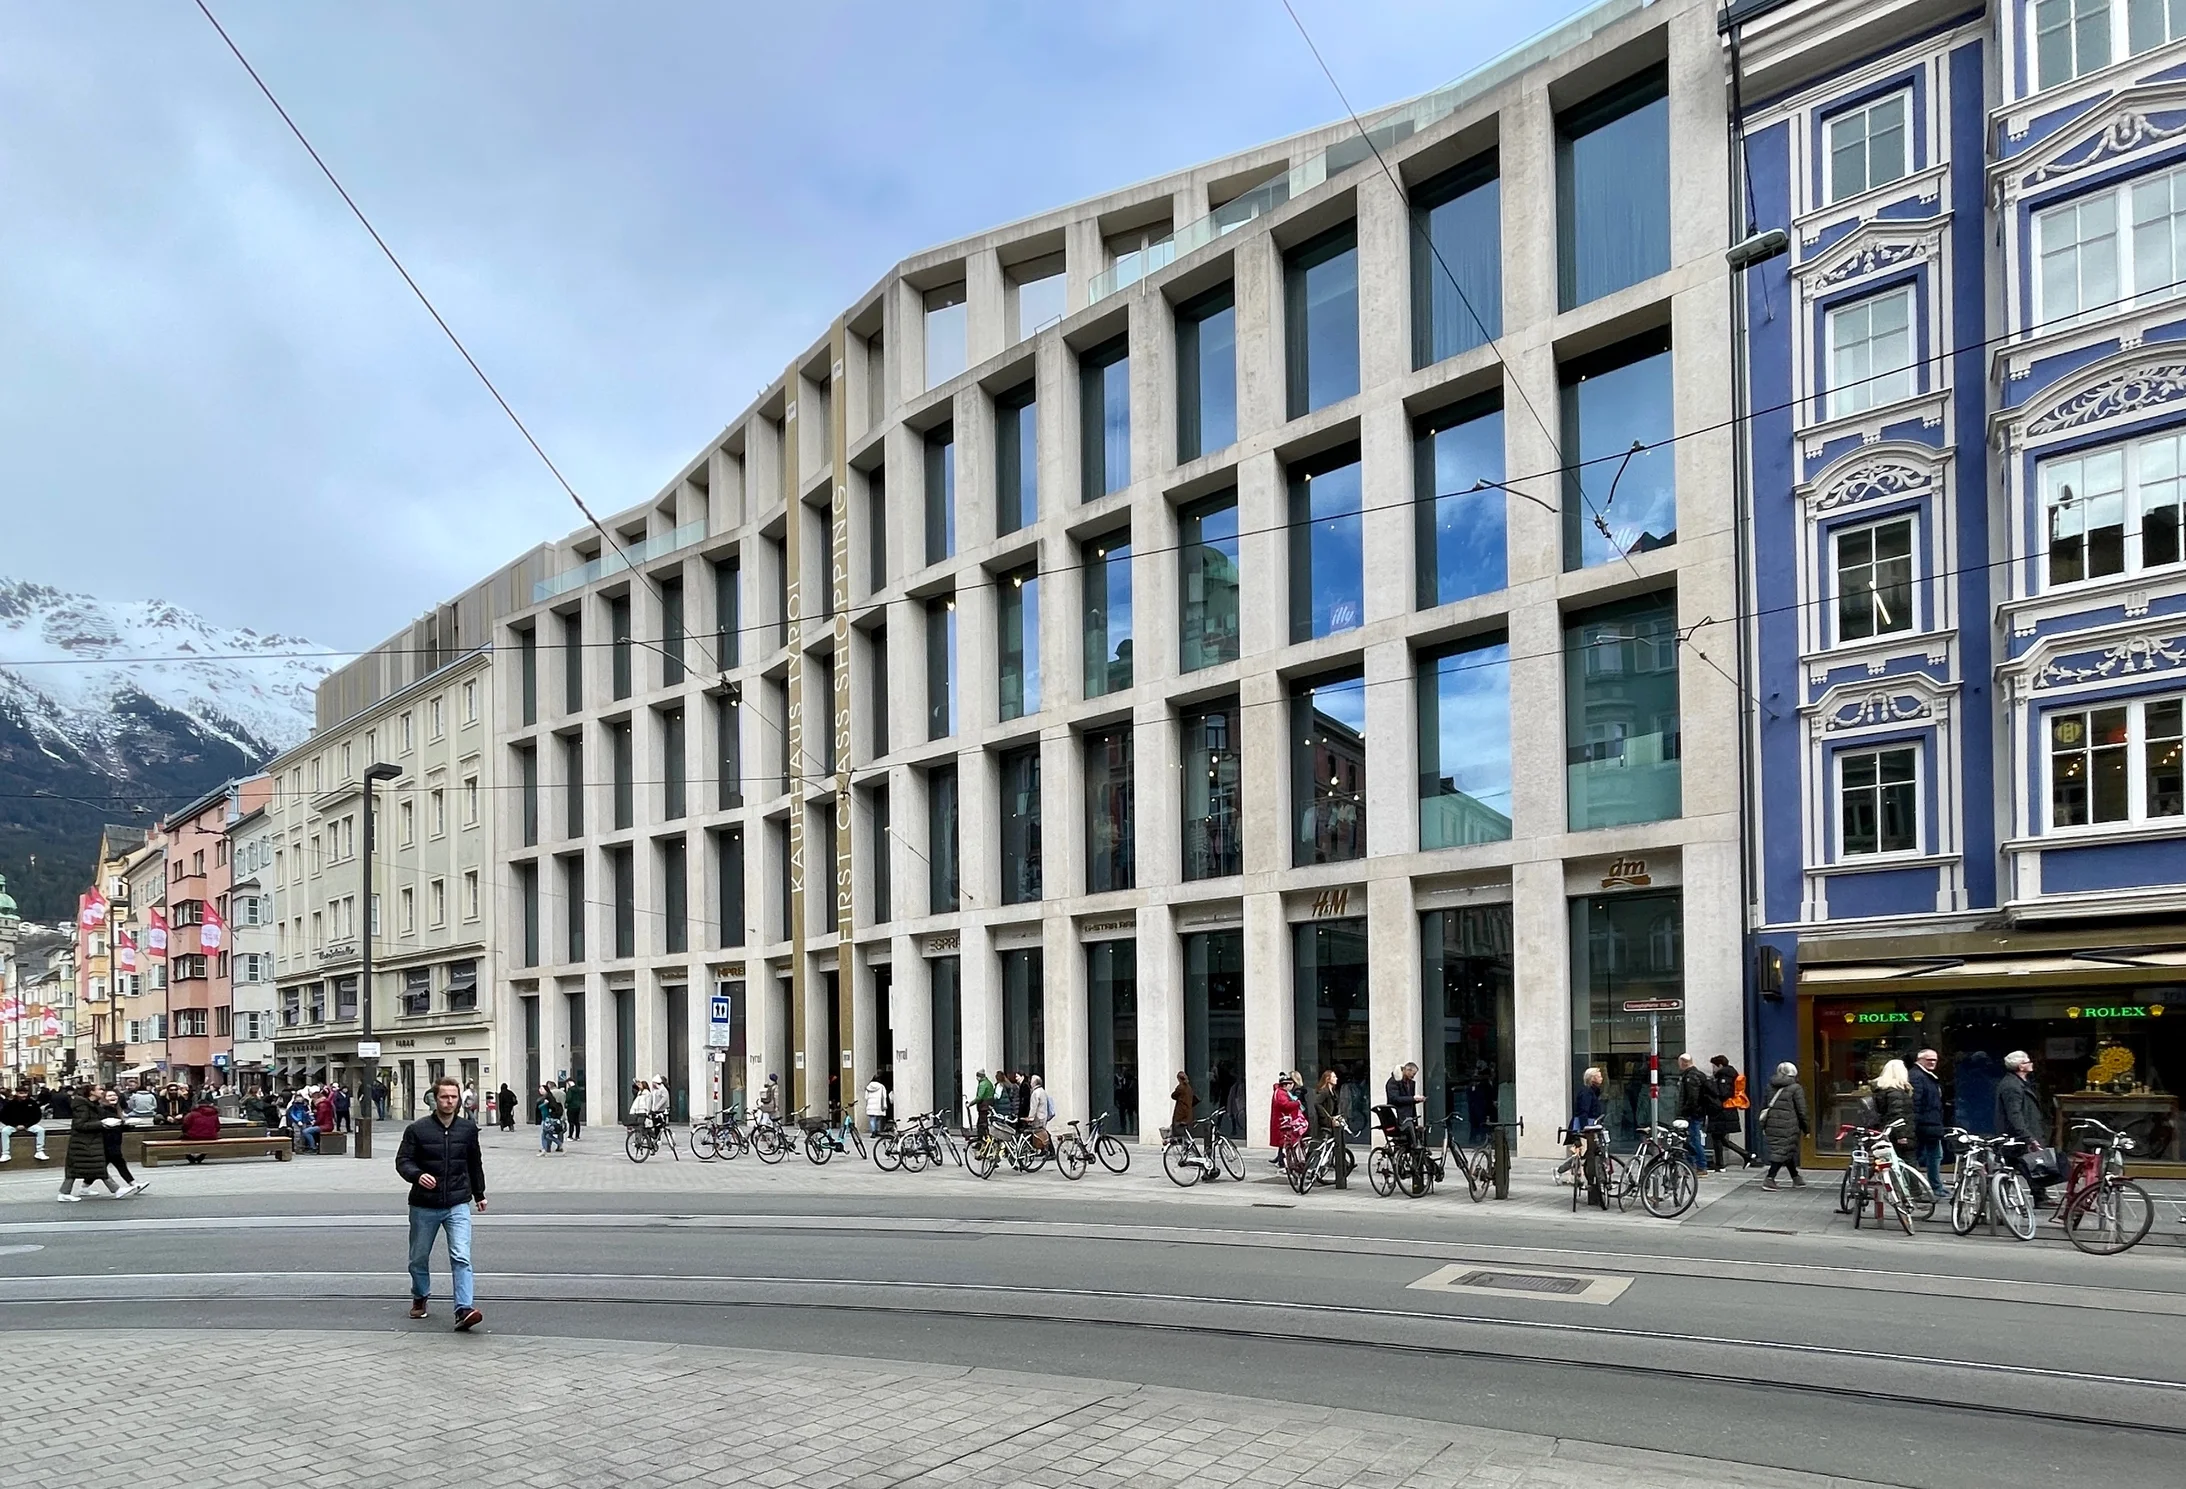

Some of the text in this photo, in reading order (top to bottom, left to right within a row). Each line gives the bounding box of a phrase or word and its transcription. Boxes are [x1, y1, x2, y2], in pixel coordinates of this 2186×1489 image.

[832, 485, 849, 692] SHOPPING
[1331, 606, 1354, 626] illy
[789, 701, 804, 893] KAUFHAUS
[1608, 857, 1646, 876] dm
[837, 851, 852, 944] FIRST
[1311, 889, 1348, 917] H&M
[1858, 1012, 1910, 1023] ROLEX
[2084, 1006, 2146, 1018] ROLEX
